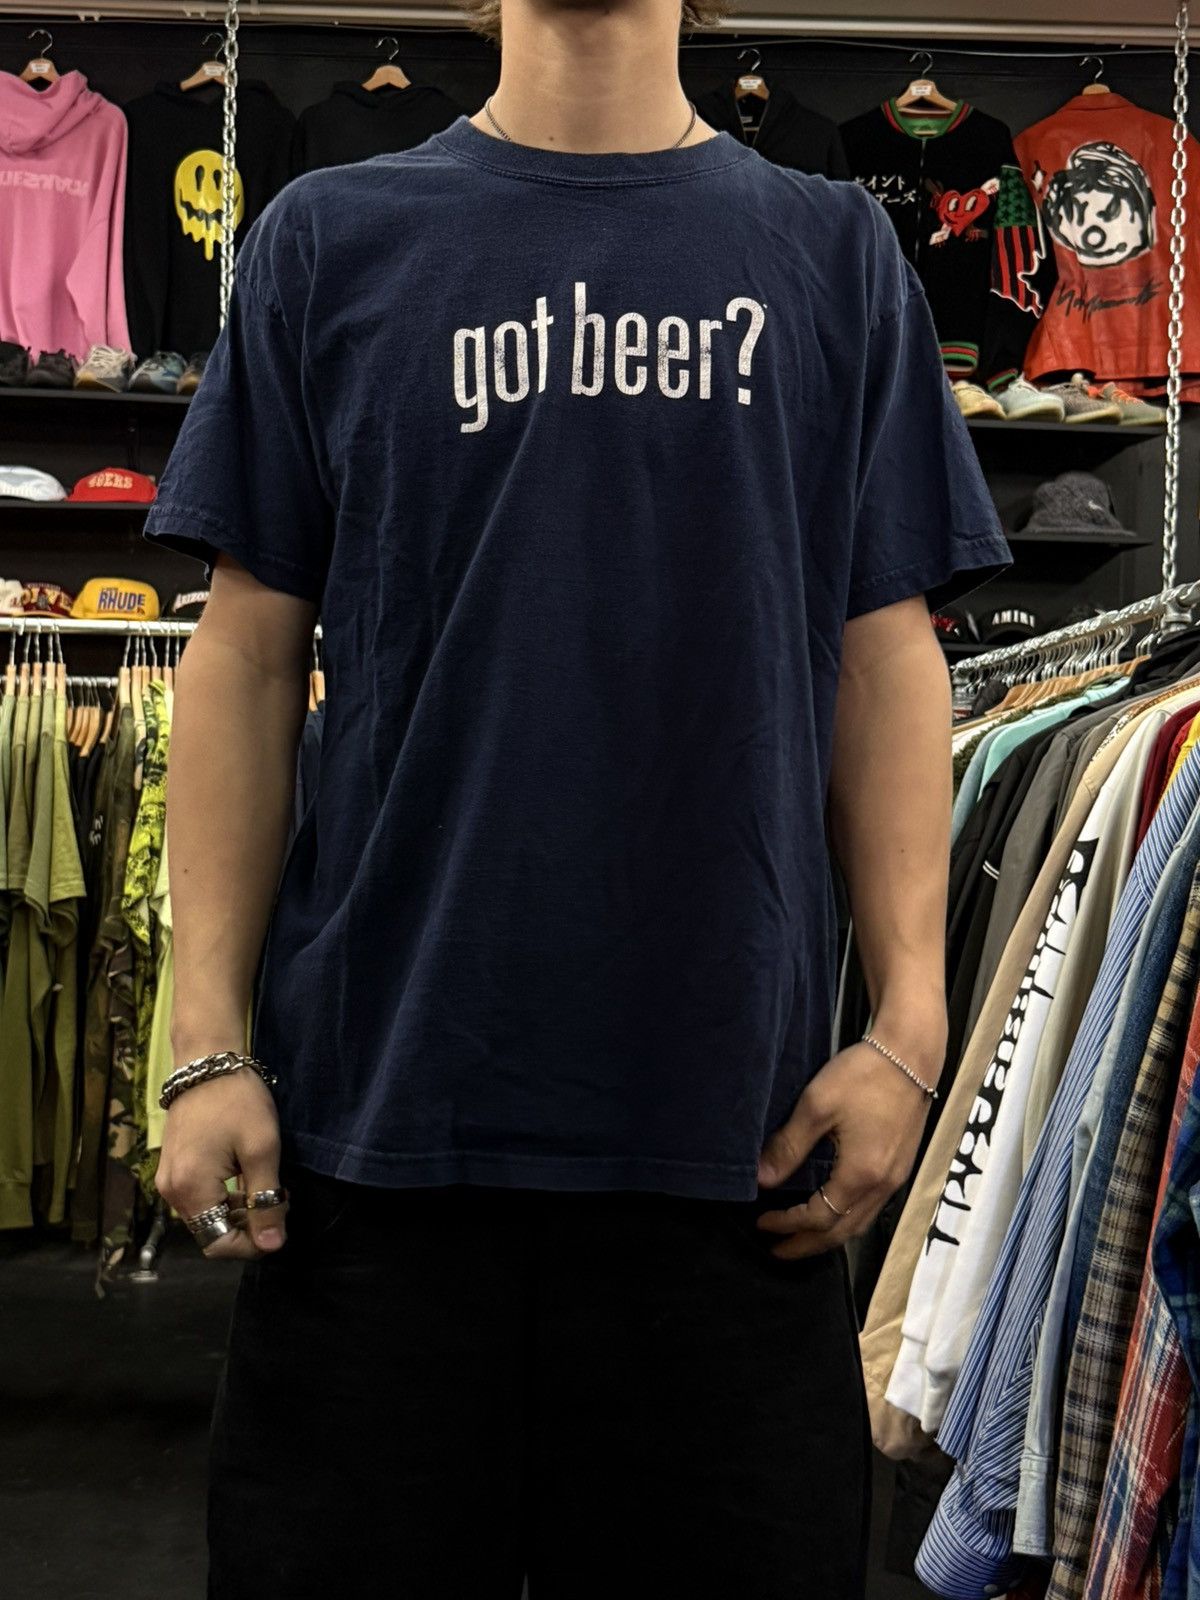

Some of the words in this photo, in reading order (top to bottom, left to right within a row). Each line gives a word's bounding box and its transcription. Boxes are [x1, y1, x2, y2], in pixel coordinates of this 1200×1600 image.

[453, 296, 554, 433] got
[571, 281, 766, 406] beer?
[88, 472, 133, 489] 49ERS
[98, 590, 146, 611] RHUDE
[992, 609, 1035, 628] AMIRI
